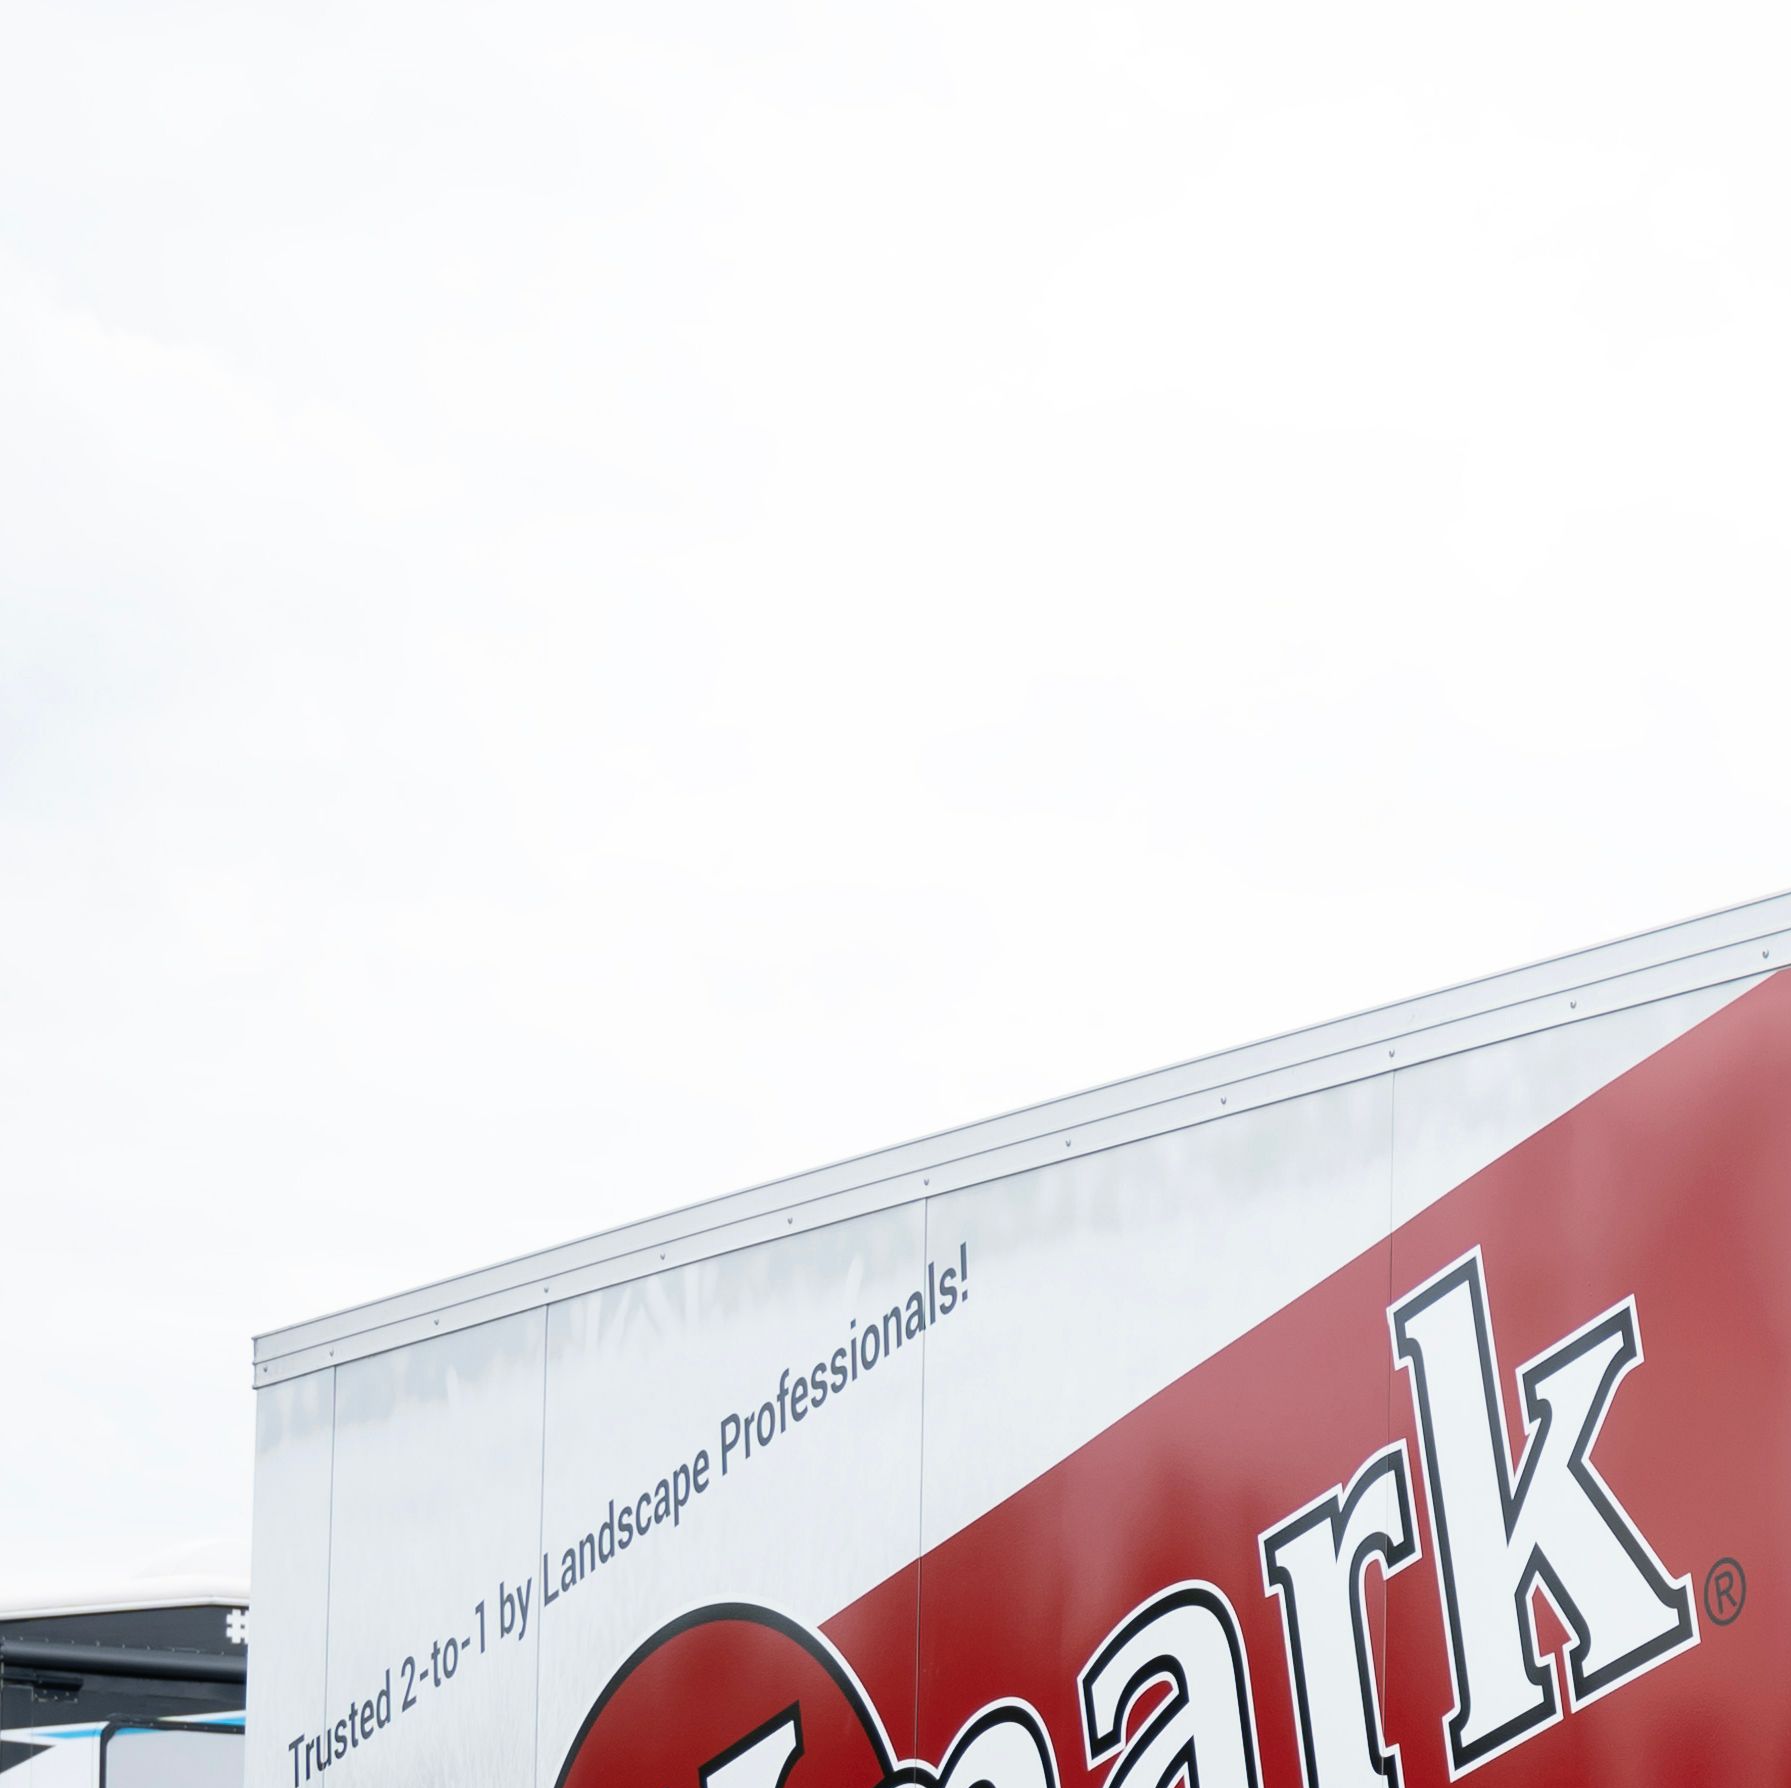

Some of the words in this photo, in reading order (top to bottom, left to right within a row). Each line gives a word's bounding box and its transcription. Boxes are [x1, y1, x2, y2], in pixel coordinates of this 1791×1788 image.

[400, 1599, 486, 1712] 2-to-1
[499, 1576, 532, 1642] by
[543, 1449, 710, 1607] Landscape
[720, 1241, 969, 1477] Professionals!
